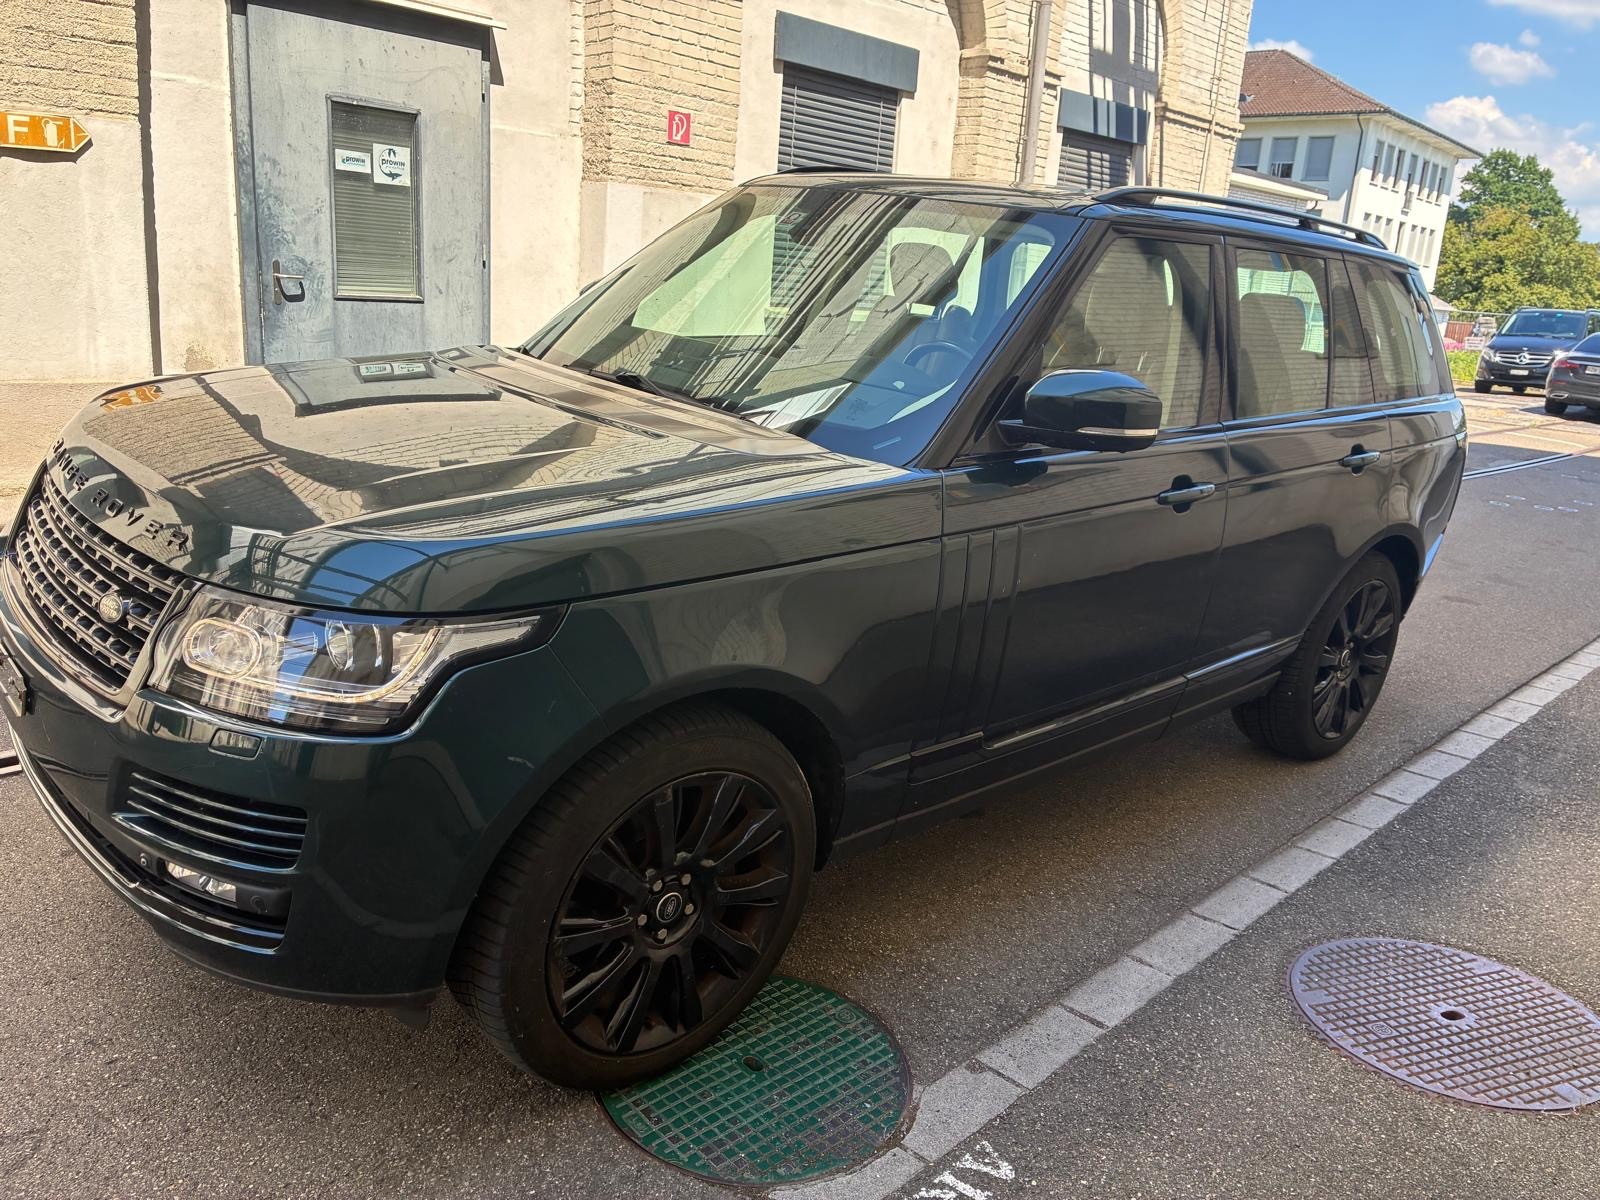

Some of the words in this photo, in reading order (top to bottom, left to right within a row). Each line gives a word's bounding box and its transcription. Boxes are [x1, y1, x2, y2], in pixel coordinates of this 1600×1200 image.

[7, 114, 30, 144] F
[53, 437, 90, 491] RANGE
[91, 488, 189, 551] ROVER
